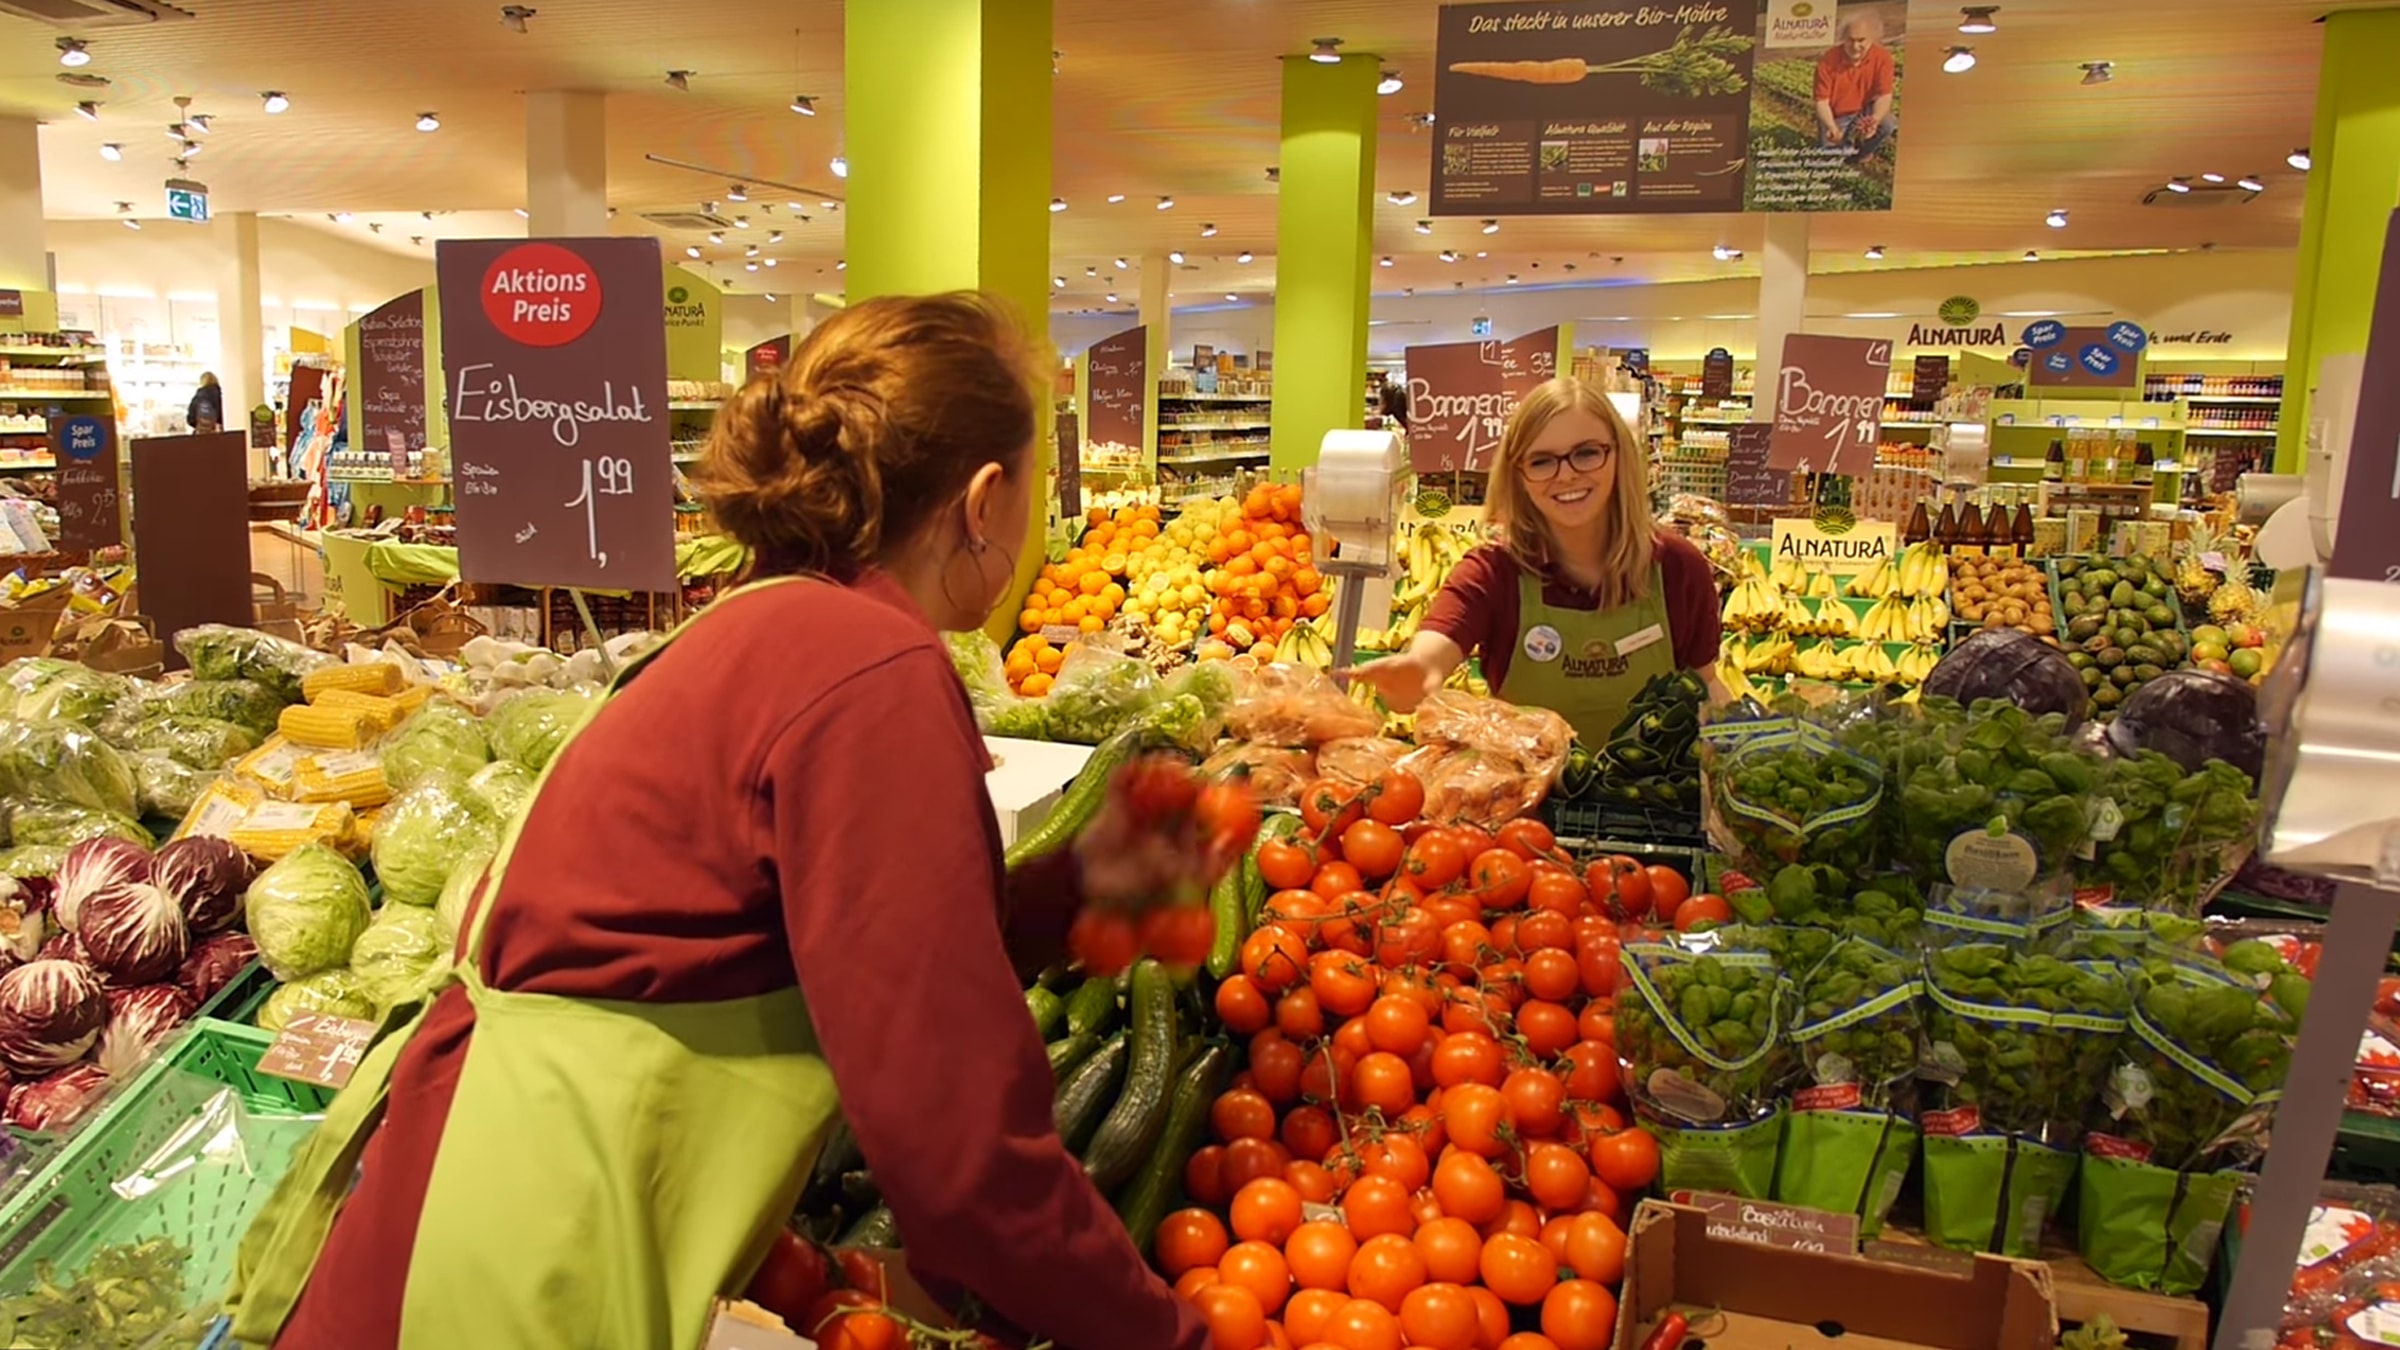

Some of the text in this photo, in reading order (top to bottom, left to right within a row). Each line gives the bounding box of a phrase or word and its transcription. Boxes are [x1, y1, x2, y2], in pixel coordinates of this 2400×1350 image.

[1468, 2, 1729, 34] Das steckt in unserer Bio-Möhre
[1773, 15, 1829, 31] ALNATURA
[492, 268, 587, 294] Aktions
[513, 297, 572, 323] Preis
[1907, 321, 2007, 347] ALNATURA
[2031, 323, 2055, 336] Spar
[2032, 332, 2057, 345] Preis
[2117, 324, 2141, 340] Spar
[2163, 331, 2196, 344] und
[2195, 330, 2233, 344] Erde
[455, 363, 652, 446] Eisbergsalat
[1406, 377, 1504, 424] Bananen
[1780, 366, 1884, 420] Bananen
[70, 424, 95, 437] Spar
[71, 436, 96, 449] Preis
[1778, 532, 1886, 559] ALNATURA
